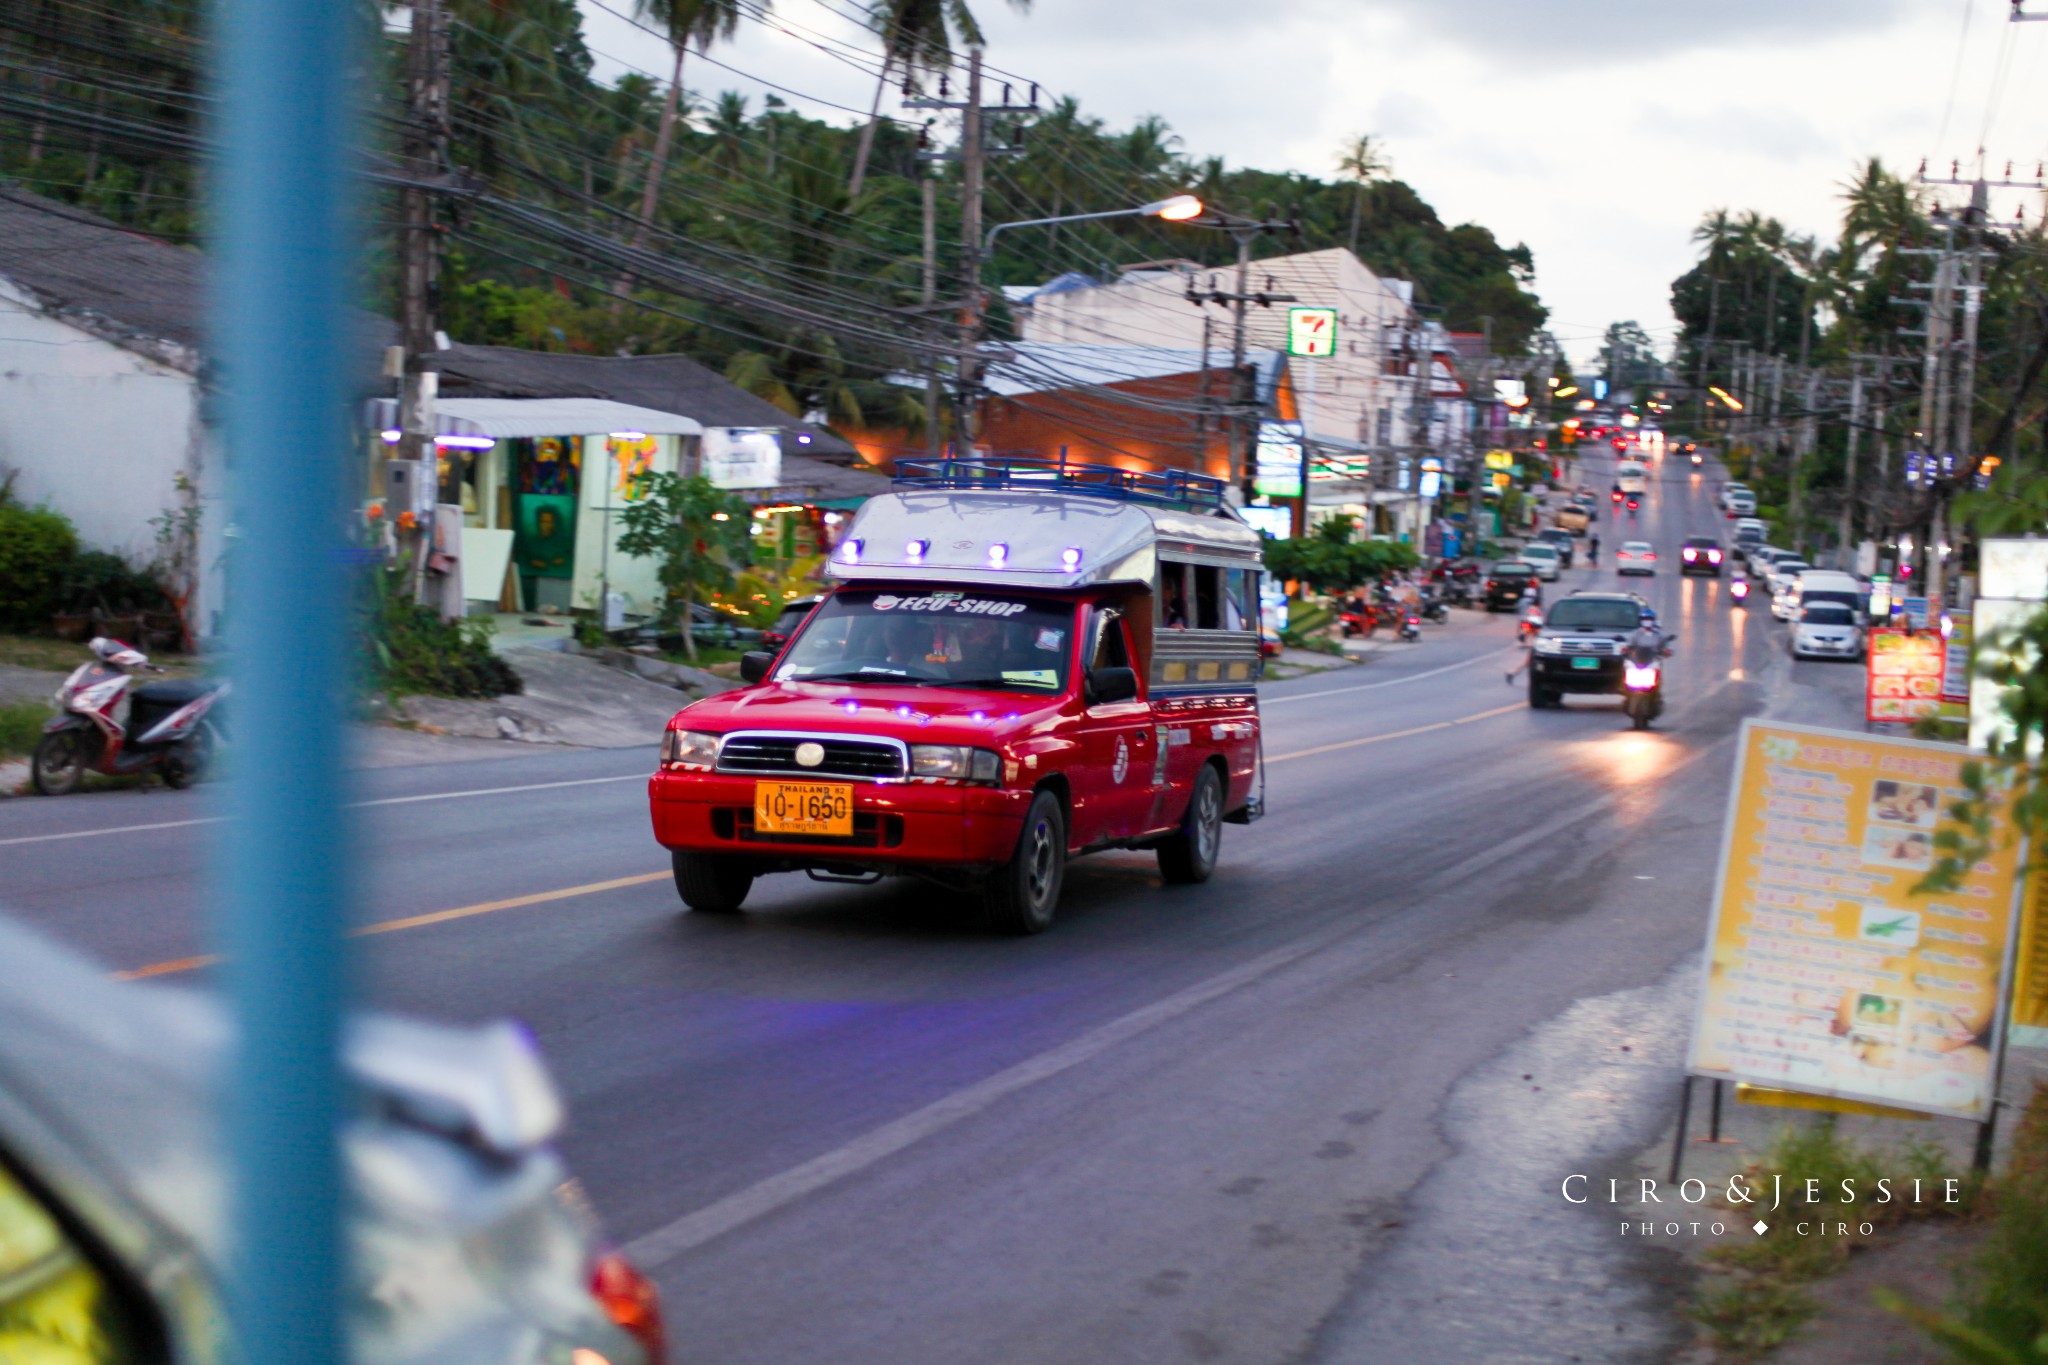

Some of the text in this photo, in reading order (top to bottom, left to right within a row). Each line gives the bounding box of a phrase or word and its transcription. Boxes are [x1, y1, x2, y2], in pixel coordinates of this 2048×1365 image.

[898, 597, 1027, 617] ECU-SHOP
[779, 785, 830, 794] THAILAND
[765, 794, 846, 819] 10-1650
